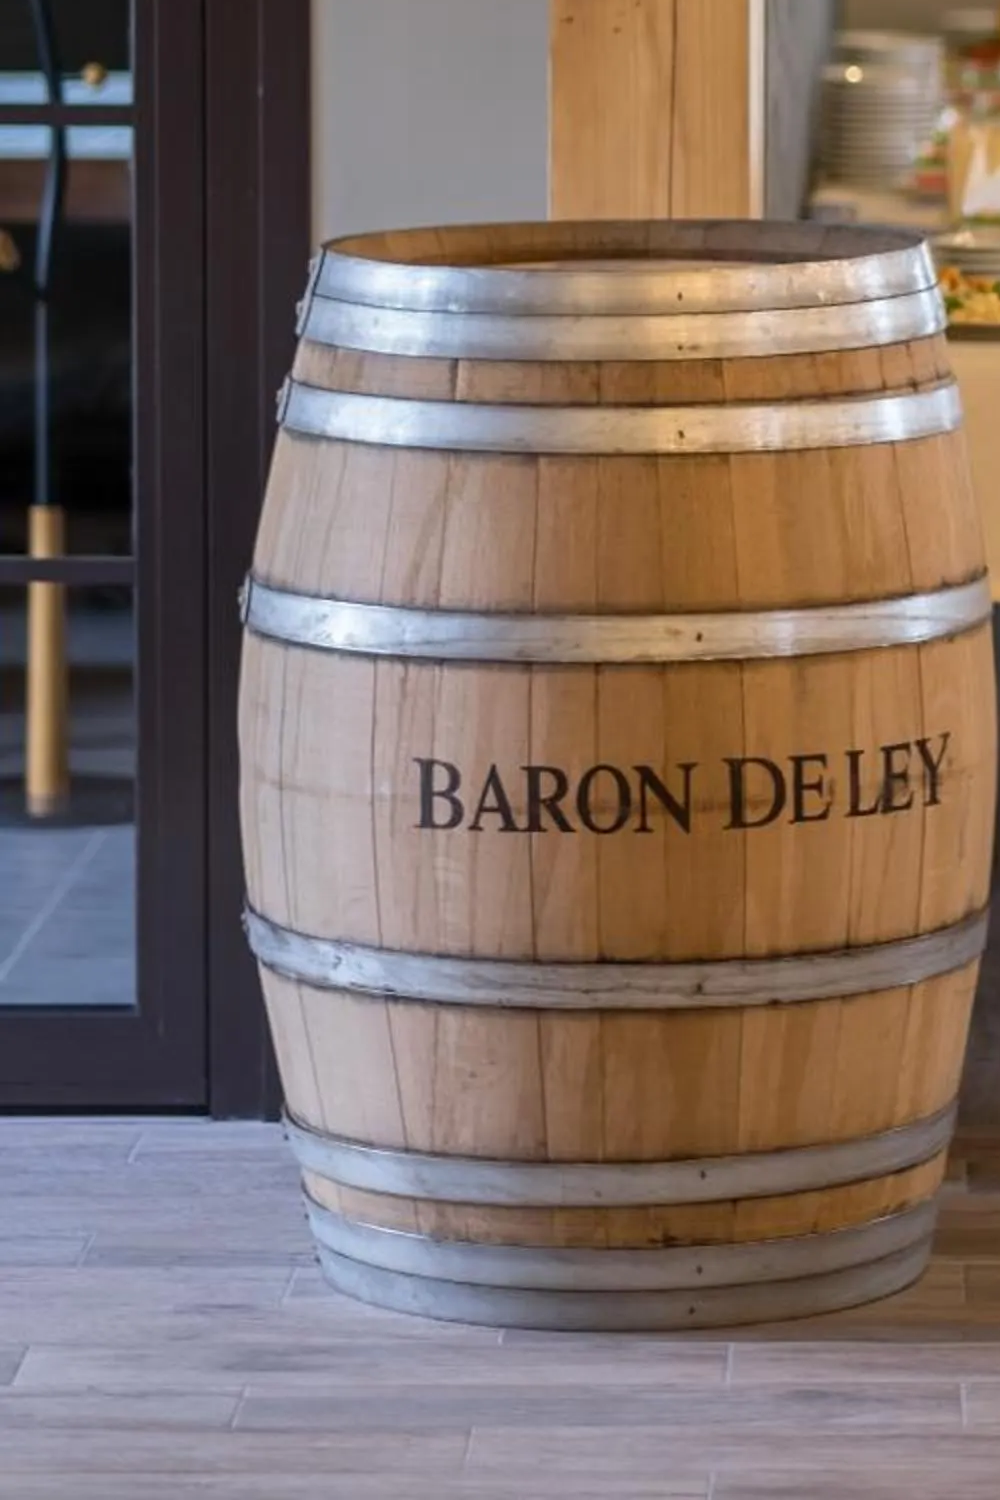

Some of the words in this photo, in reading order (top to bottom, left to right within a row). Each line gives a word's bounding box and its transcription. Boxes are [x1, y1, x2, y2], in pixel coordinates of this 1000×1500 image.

[414, 757, 698, 835] BARON
[722, 754, 832, 830] DE
[845, 732, 951, 818] LEY
